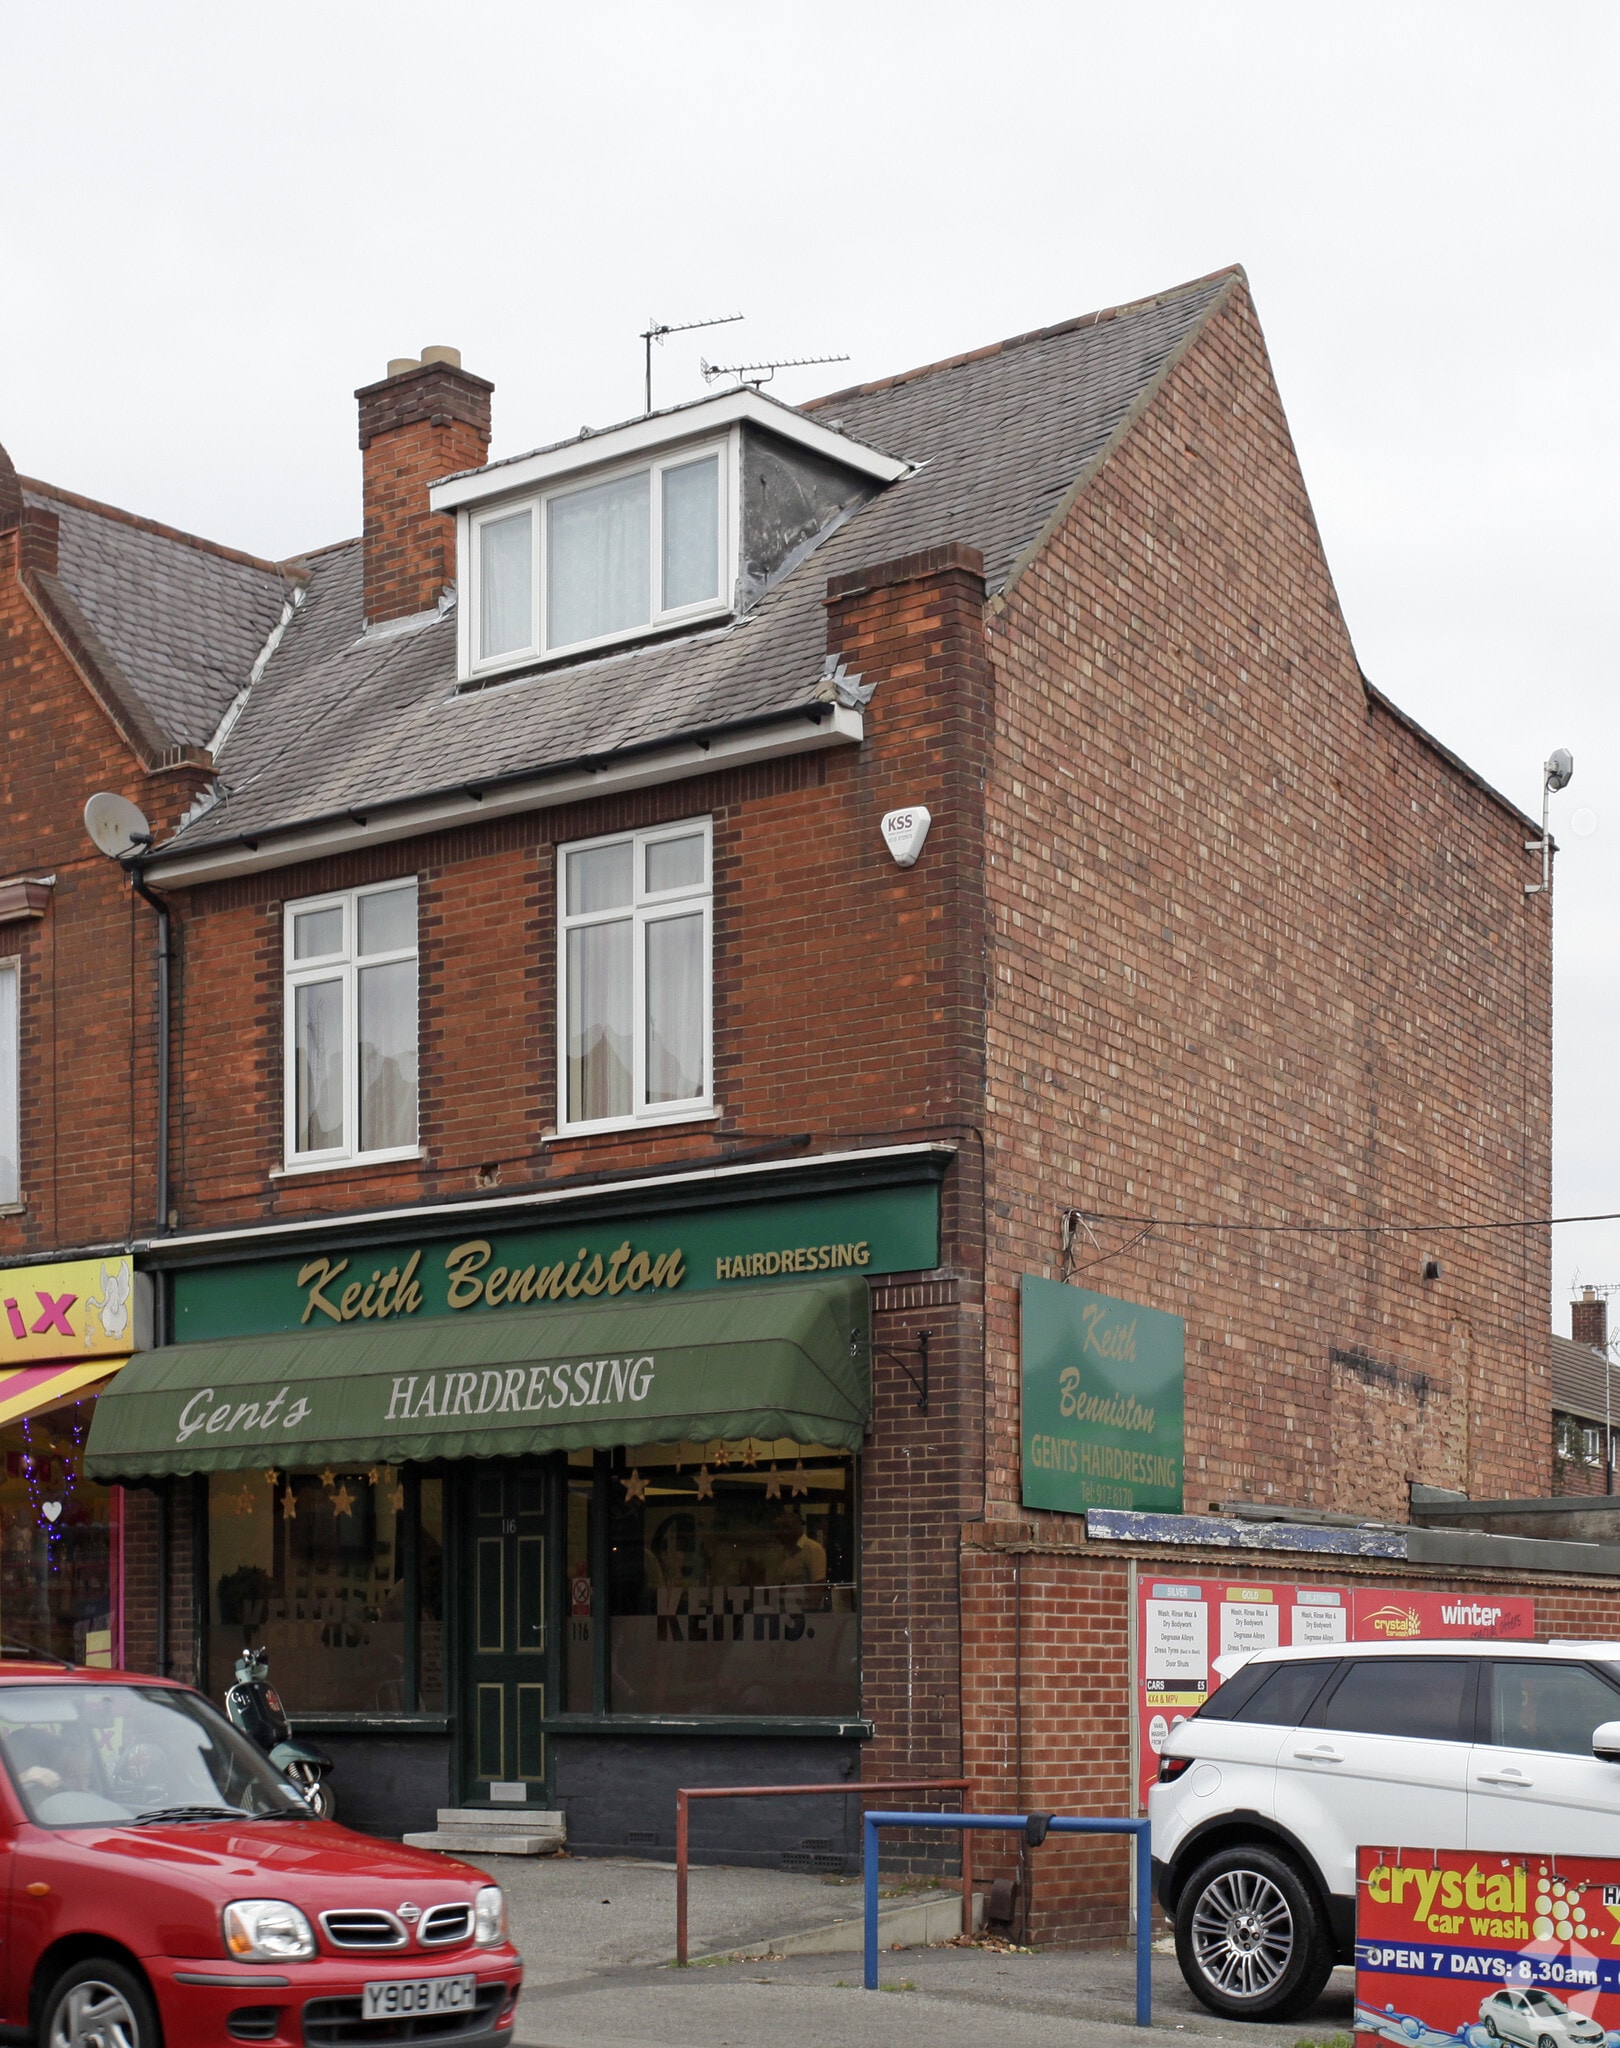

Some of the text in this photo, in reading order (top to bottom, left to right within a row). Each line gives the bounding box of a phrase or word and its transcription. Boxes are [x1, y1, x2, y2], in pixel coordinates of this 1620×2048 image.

[888, 814, 913, 832] KSS
[715, 1241, 870, 1280] HAIRDRESSING
[297, 1240, 686, 1324] Keith Benniston
[1081, 1304, 1137, 1364] Keith
[176, 1356, 655, 1443] Gents HAIRDRESSING
[1059, 1366, 1156, 1434] Benniston
[1031, 1433, 1176, 1488] GENTS HAIRDRESSING
[1081, 1481, 1096, 1503] Tel:
[502, 1519, 517, 1534] 116
[1167, 1587, 1188, 1597] SILVER
[1242, 1591, 1259, 1600] GOLD
[1171, 1610, 1184, 1618] Rinse
[1235, 1619, 1264, 1628] Dry Bodywork
[1441, 1600, 1501, 1627] winter
[573, 1622, 589, 1641] 116
[1163, 1620, 1192, 1629] Dry Bodywork
[1374, 1618, 1408, 1631] crystal
[1160, 1633, 1194, 1642] Degrease Alloys
[1147, 1680, 1205, 1690] CARS £5
[1148, 1694, 1159, 1704] 4X4
[1160, 1695, 1165, 1704] &
[1165, 1695, 1178, 1704] MPV
[1368, 1863, 1527, 1922] crystal
[1428, 1914, 1529, 1939] car wash
[1367, 1948, 1425, 1970] OPEN
[1431, 1953, 1444, 1971] 7
[1451, 1956, 1512, 1977] DAYS:
[1519, 1961, 1598, 1985] 8.30am
[368, 1983, 429, 2014] Y908
